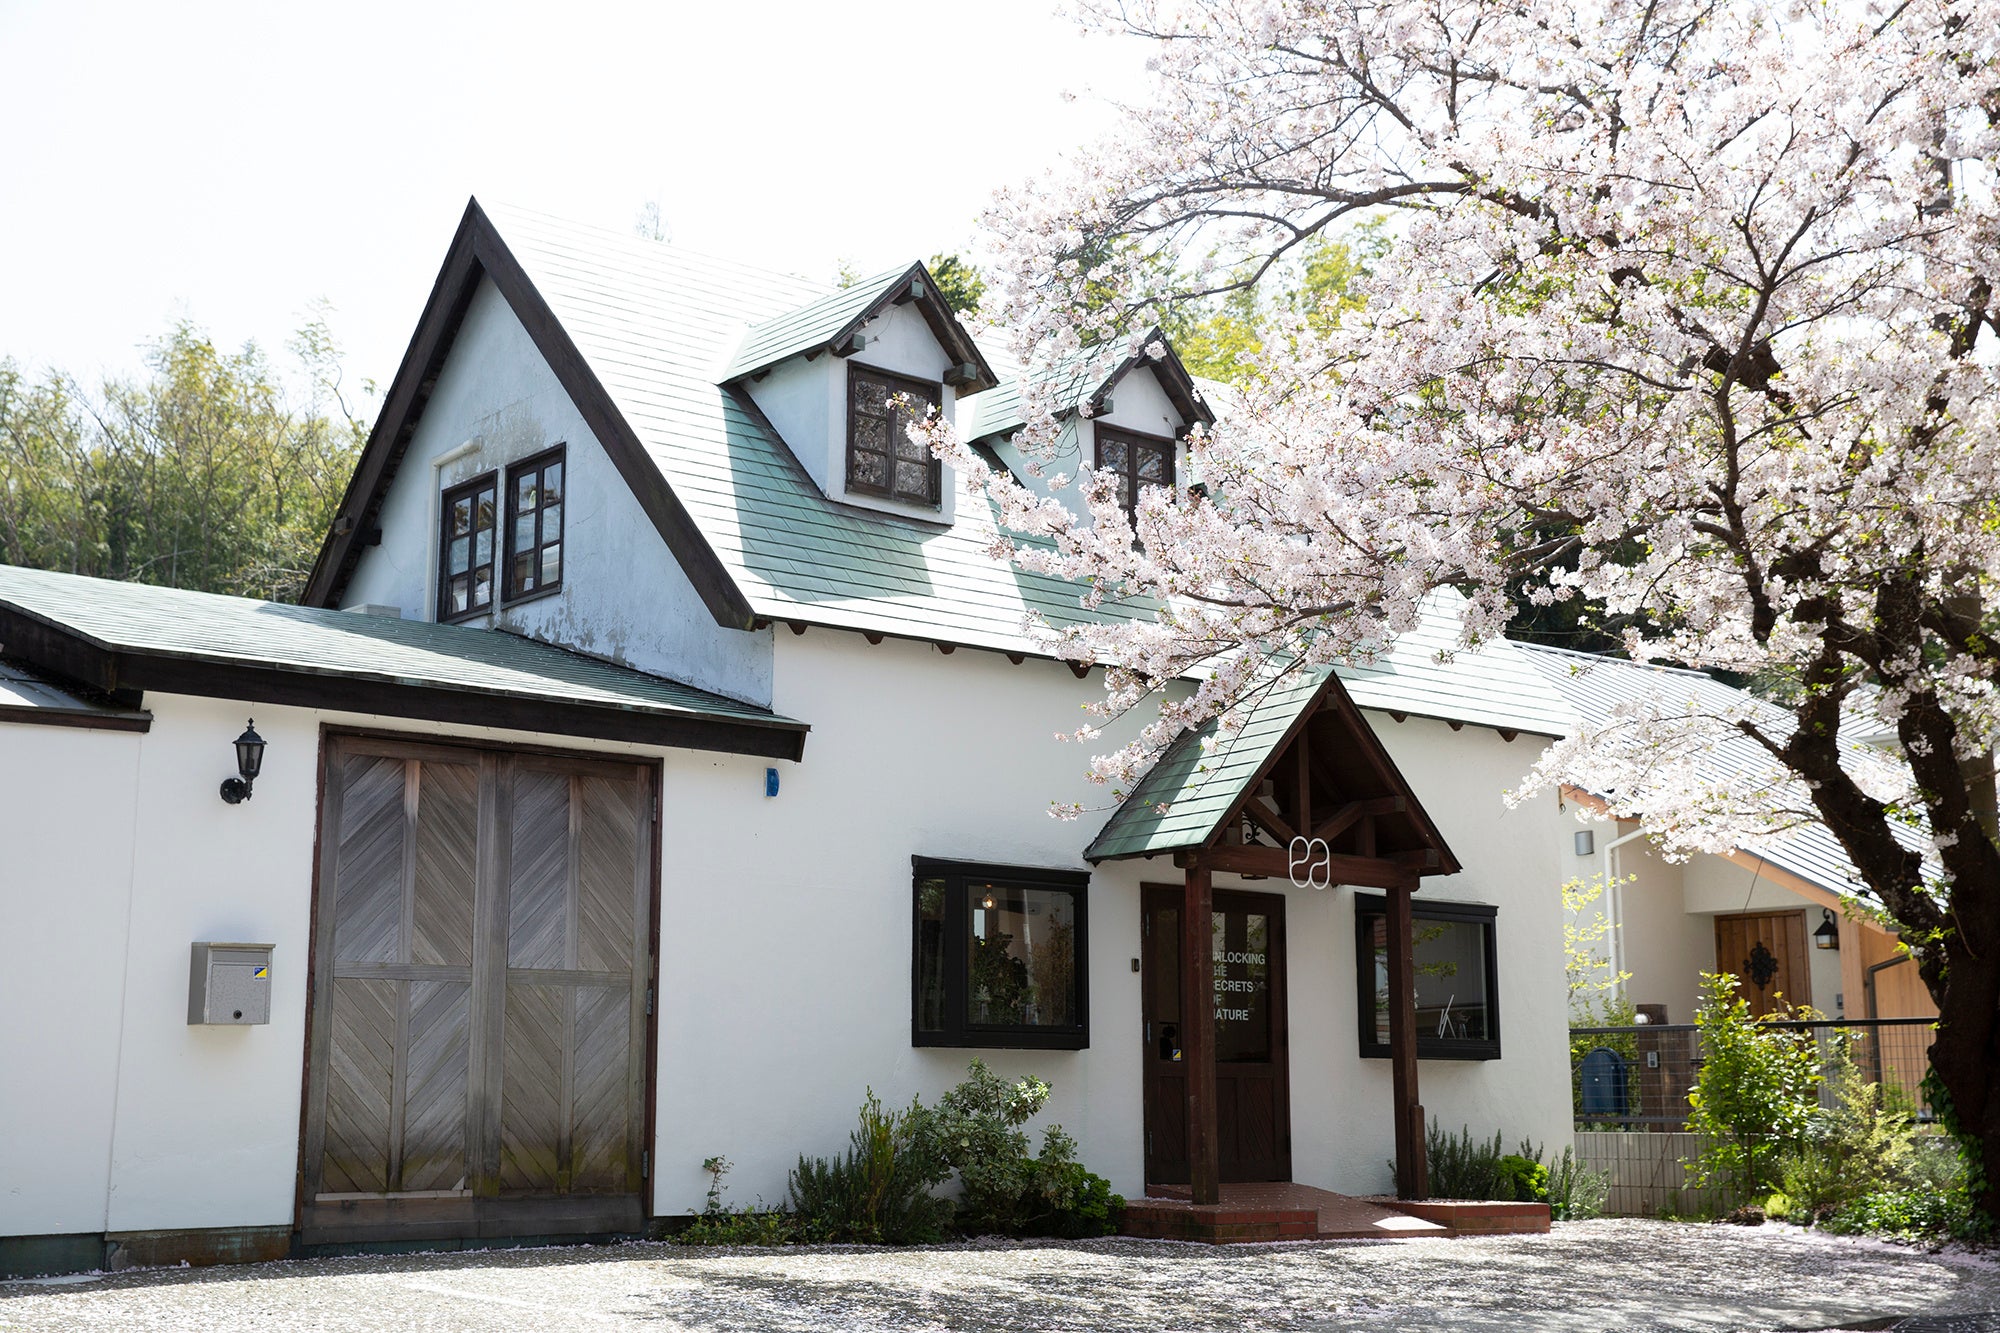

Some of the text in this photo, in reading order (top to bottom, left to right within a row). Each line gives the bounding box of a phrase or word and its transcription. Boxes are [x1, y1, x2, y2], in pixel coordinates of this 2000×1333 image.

[1213, 951, 1266, 965] NLOCKING
[1213, 965, 1228, 977] HE
[1213, 980, 1254, 993] ECRETS
[1213, 1008, 1249, 1021] ATURE
